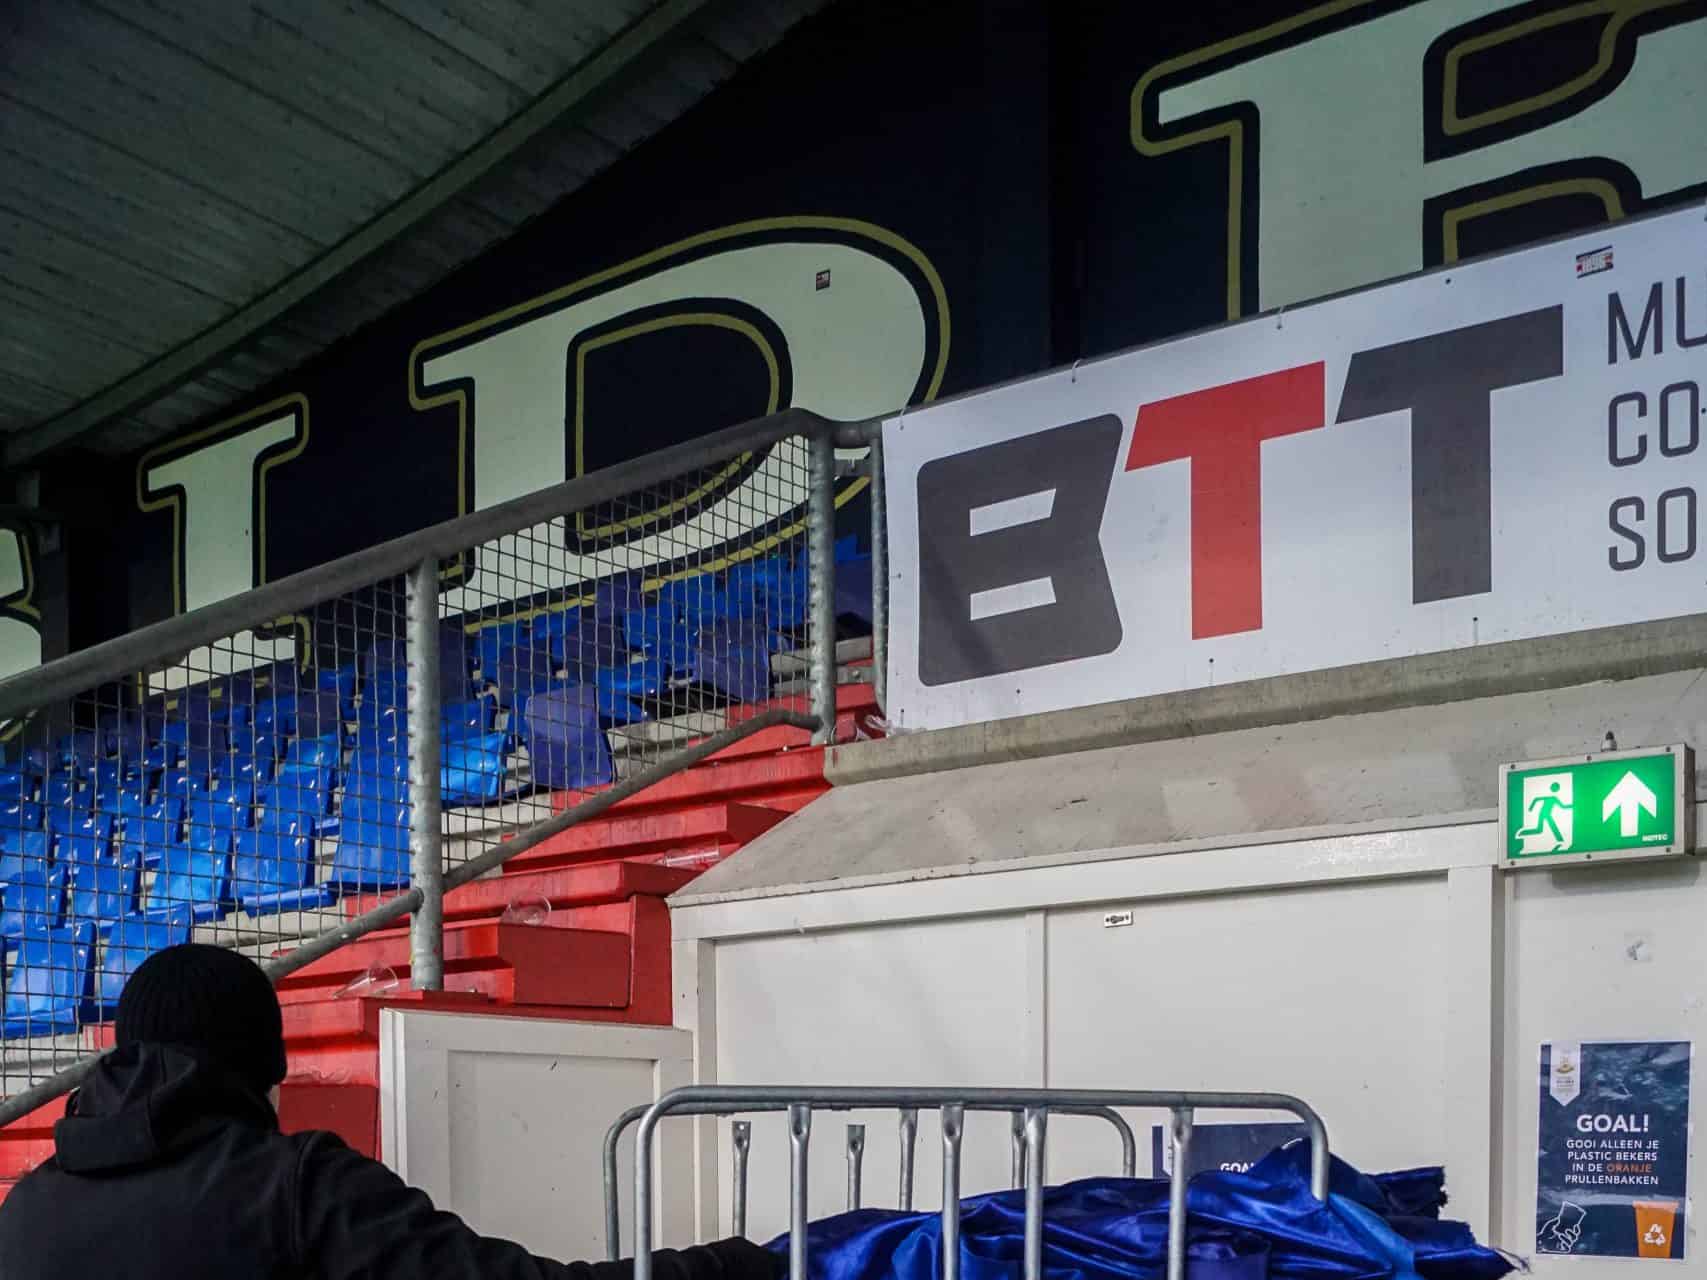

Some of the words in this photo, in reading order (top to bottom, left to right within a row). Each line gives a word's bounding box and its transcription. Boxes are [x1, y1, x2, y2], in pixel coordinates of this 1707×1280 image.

[1608, 380, 1700, 467] CO
[917, 304, 1563, 687] BTT
[1608, 486, 1697, 571] SO
[1576, 1114, 1649, 1132] GOAL!
[1566, 1140, 1596, 1149] GOOI
[1600, 1140, 1642, 1149] ALLEEN
[1646, 1140, 1659, 1149] JE
[1567, 1152, 1612, 1161] PLASTIC
[1616, 1152, 1657, 1161] BEKERS
[1572, 1163, 1584, 1172] IN
[1588, 1163, 1603, 1172] DE
[1606, 1163, 1652, 1172] ORANJE
[1565, 1175, 1659, 1184] PRULLENBAKKEN
